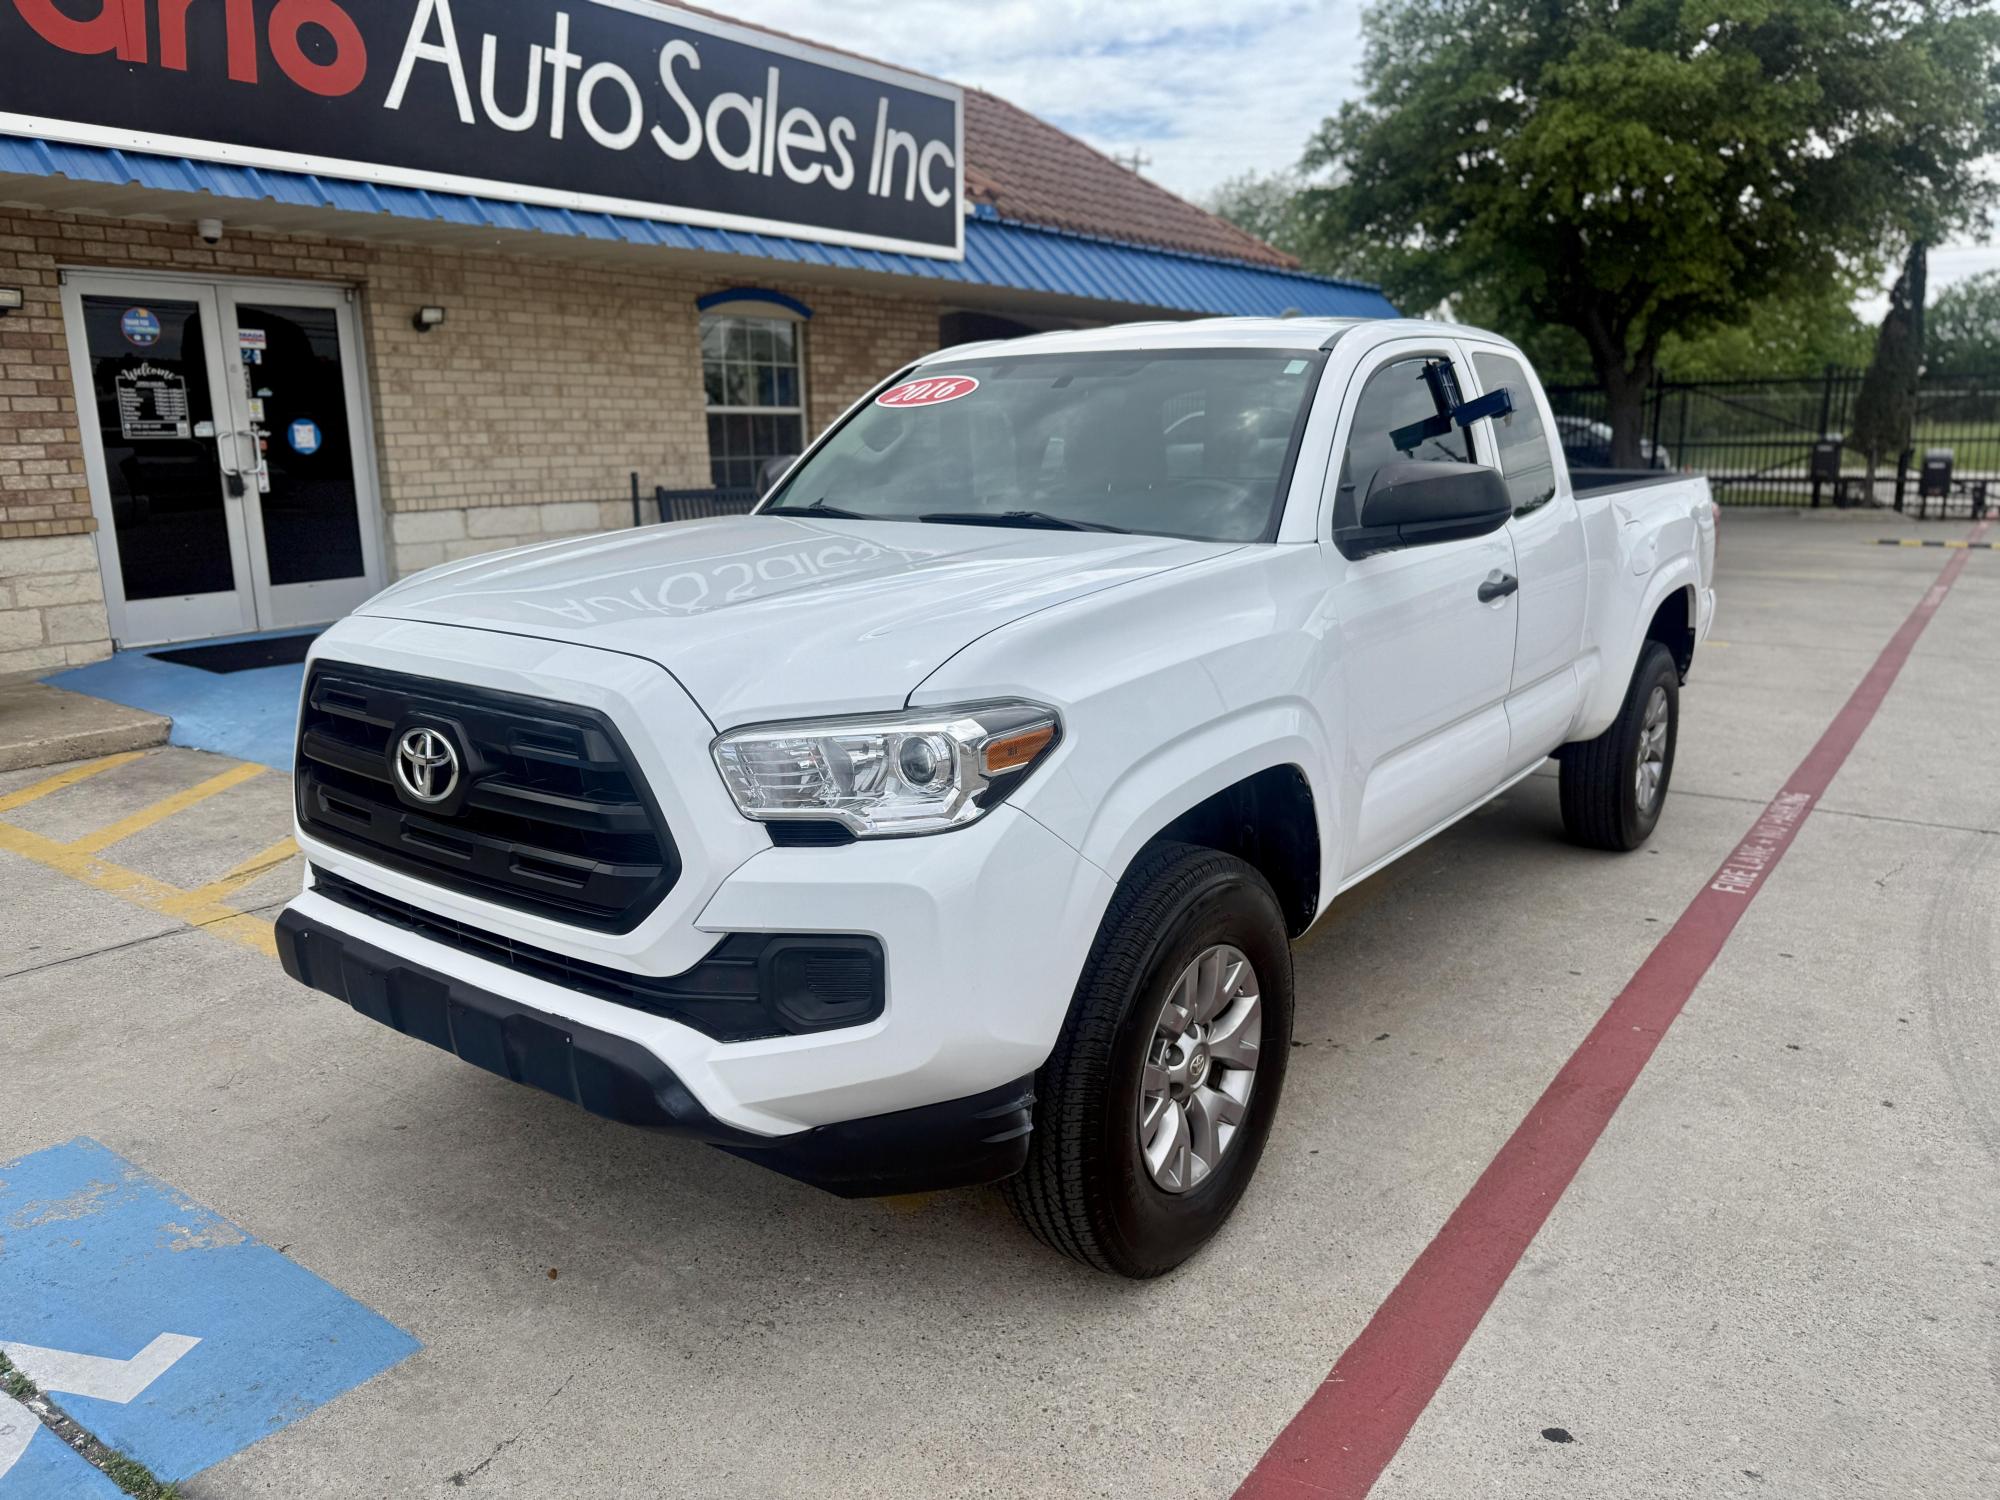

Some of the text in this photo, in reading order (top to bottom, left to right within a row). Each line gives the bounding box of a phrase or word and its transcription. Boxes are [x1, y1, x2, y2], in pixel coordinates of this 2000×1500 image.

[384, 0, 644, 150] Auto
[651, 39, 857, 190] Sales
[868, 97, 955, 207] Inc
[121, 362, 177, 382] Welcome
[884, 380, 969, 404] 2016
[1710, 868, 1759, 895] FIRE
